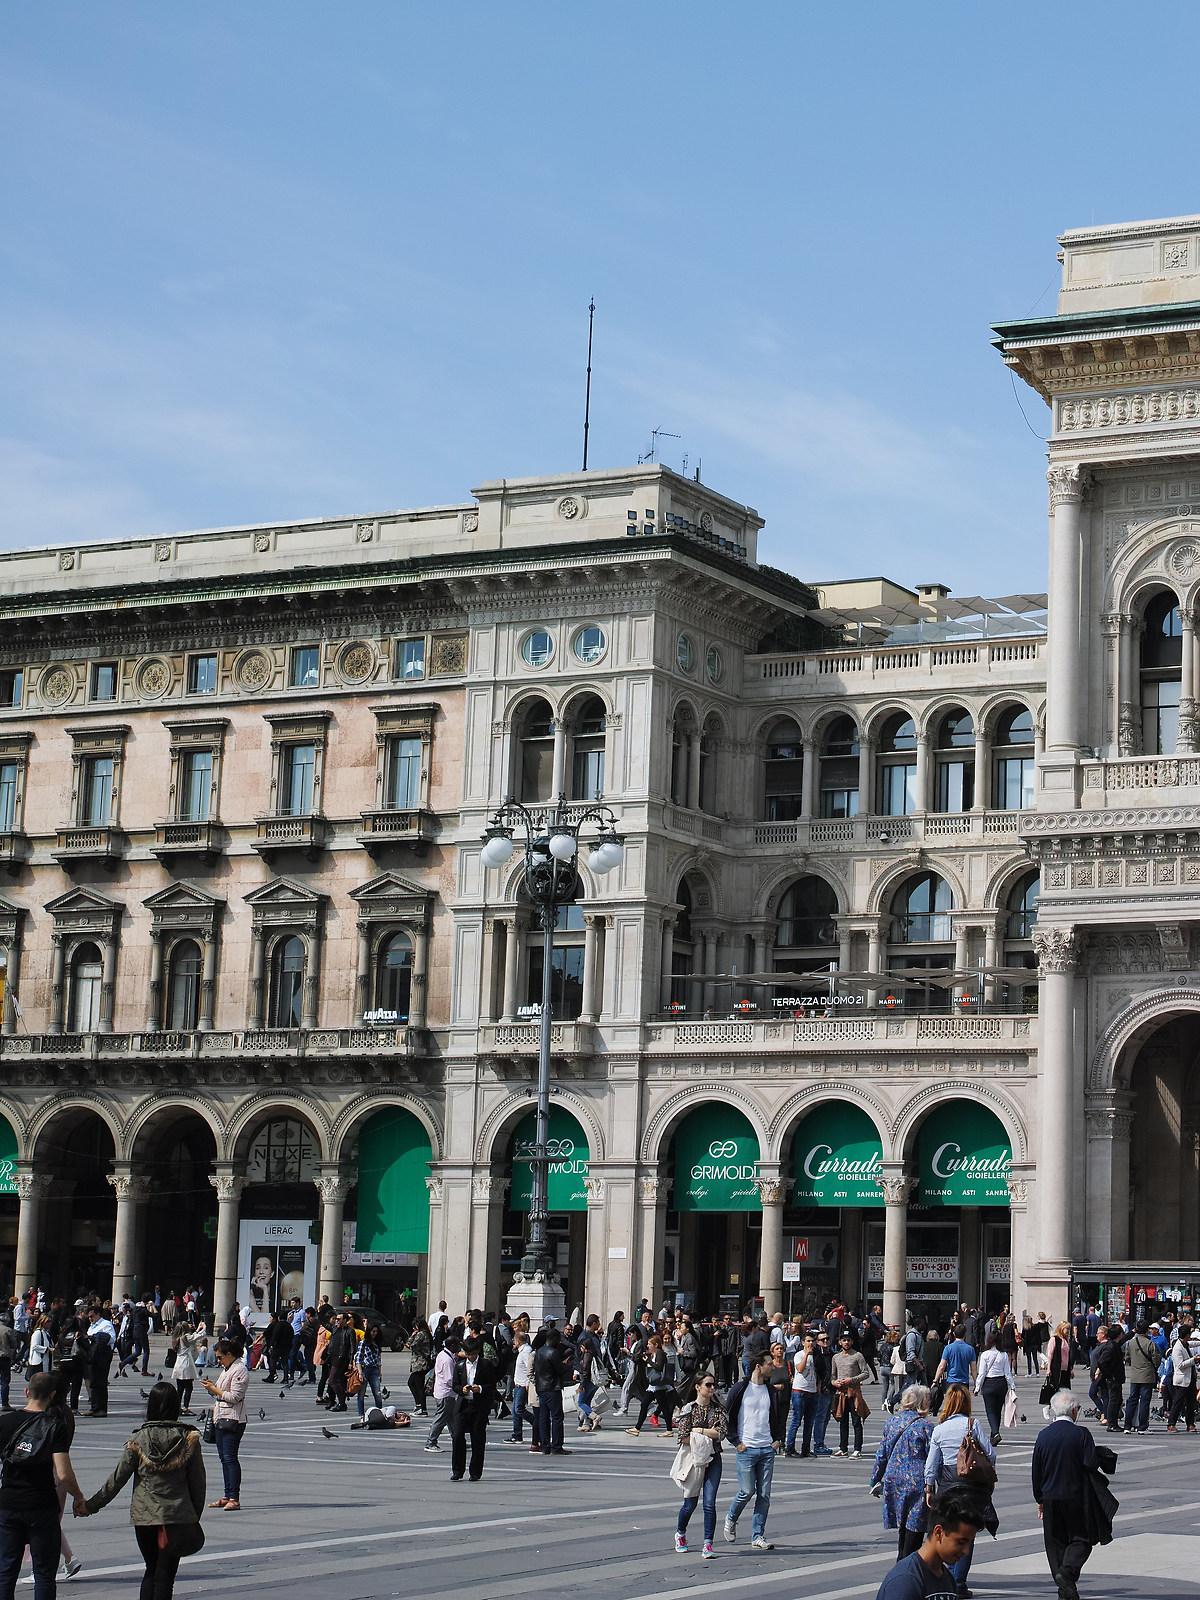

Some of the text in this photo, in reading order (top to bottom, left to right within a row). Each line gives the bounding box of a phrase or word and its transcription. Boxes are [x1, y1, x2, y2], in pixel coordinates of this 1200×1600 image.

[771, 995, 864, 1007] TERRAZZA DUOMO 21
[363, 1008, 397, 1020] LAVAZZA
[690, 1165, 757, 1180] GRIMOLDI
[264, 1226, 293, 1235] LIERAC
[796, 1243, 807, 1257] M
